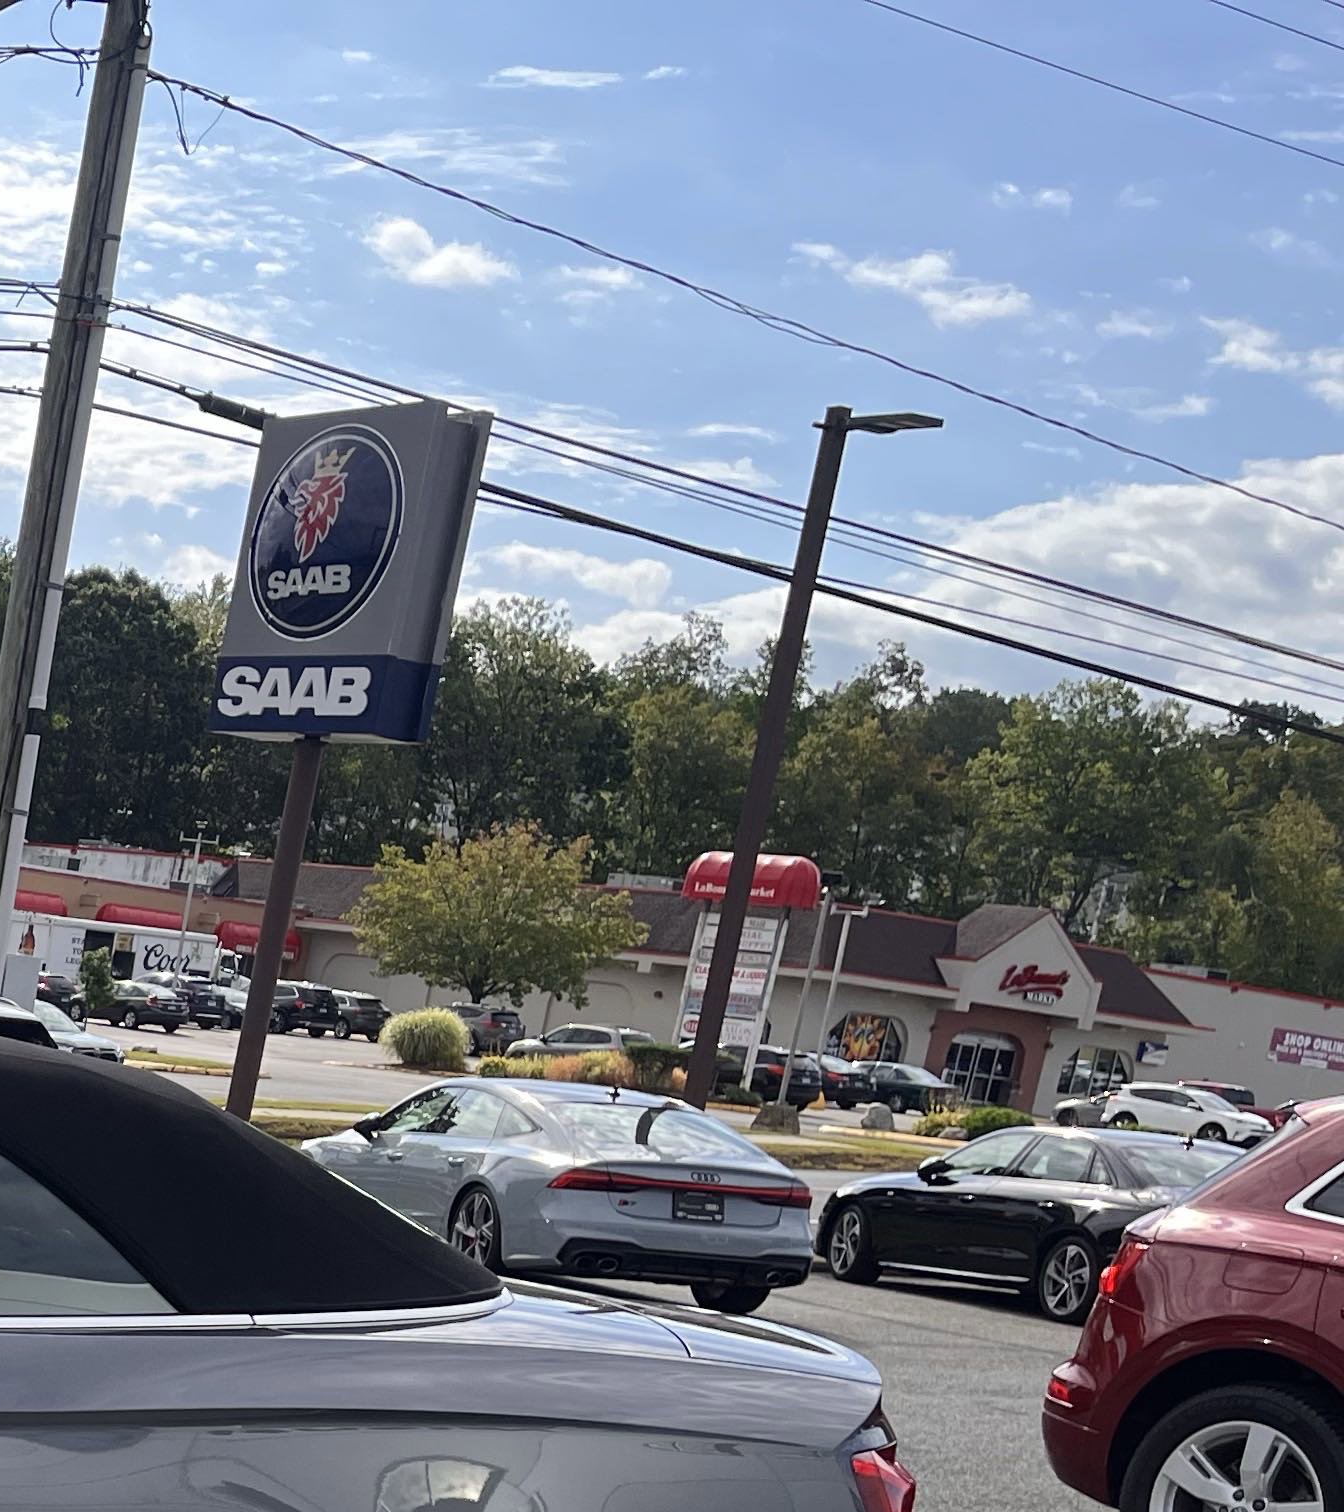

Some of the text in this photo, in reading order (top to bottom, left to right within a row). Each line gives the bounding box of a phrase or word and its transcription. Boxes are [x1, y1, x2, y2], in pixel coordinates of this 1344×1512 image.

[266, 564, 352, 601] SAAB
[216, 665, 372, 717] SAAB
[1283, 1031, 1312, 1049] SHOP
